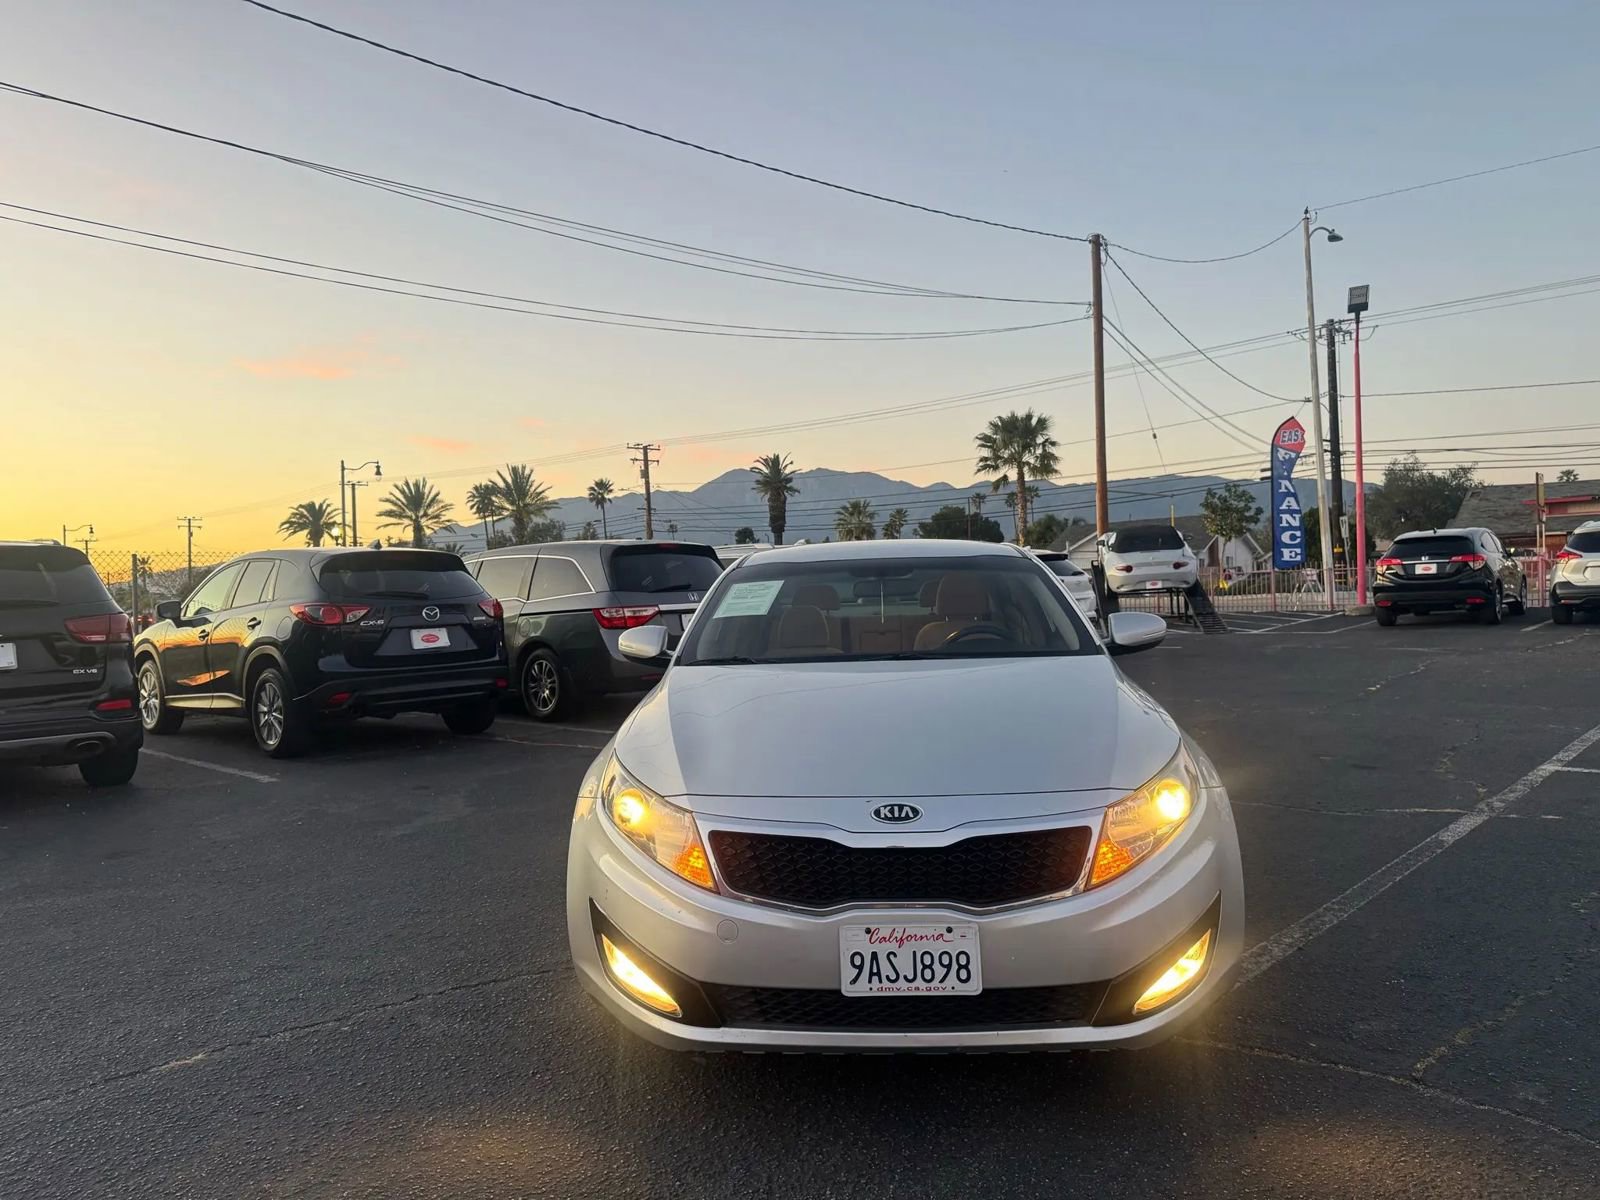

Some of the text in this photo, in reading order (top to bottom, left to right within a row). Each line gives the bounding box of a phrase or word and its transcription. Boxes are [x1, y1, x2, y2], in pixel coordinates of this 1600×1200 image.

[1277, 447, 1301, 561] FNANCE
[879, 805, 914, 819] KIA
[868, 927, 954, 948] California
[849, 950, 972, 985] 9ASJ898
